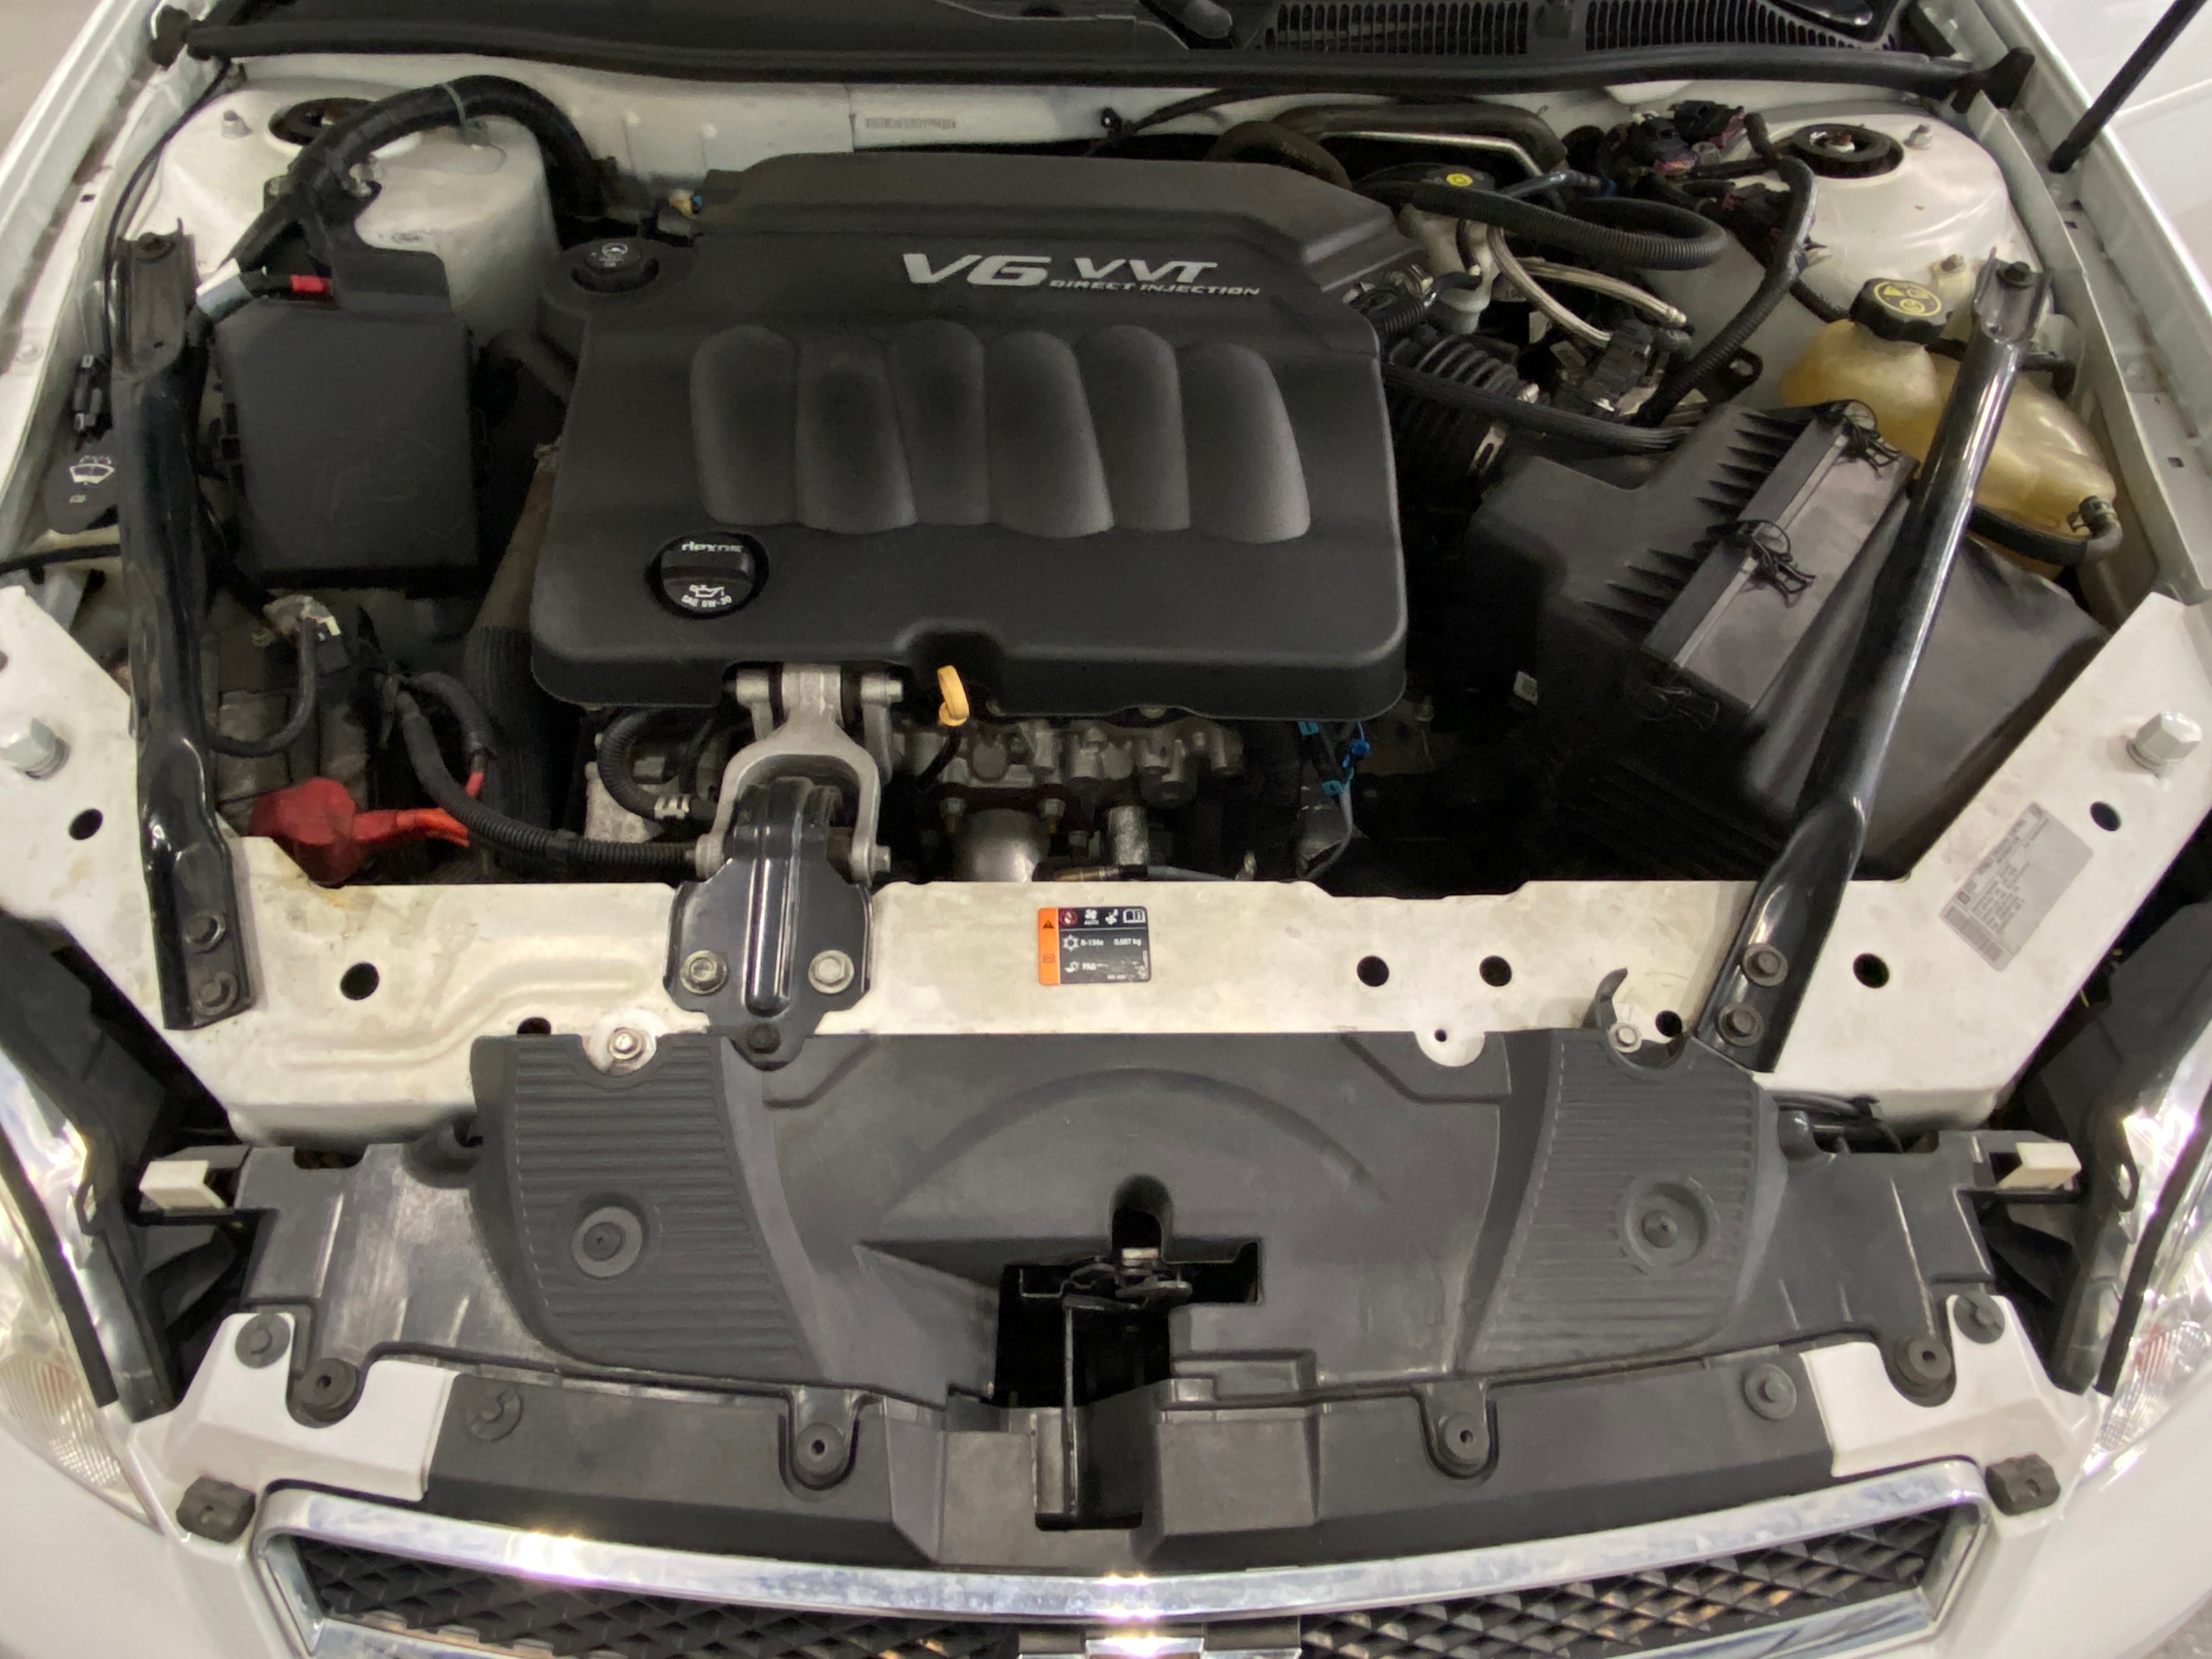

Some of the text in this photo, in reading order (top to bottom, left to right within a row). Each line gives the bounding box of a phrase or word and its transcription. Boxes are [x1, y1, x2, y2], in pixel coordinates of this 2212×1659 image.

[902, 253, 1218, 287] V6 VVT
[1049, 279, 1260, 296] DIRECT INJECTION
[681, 595, 732, 607] SAE 5W-30
[1133, 938, 1142, 948] kg
